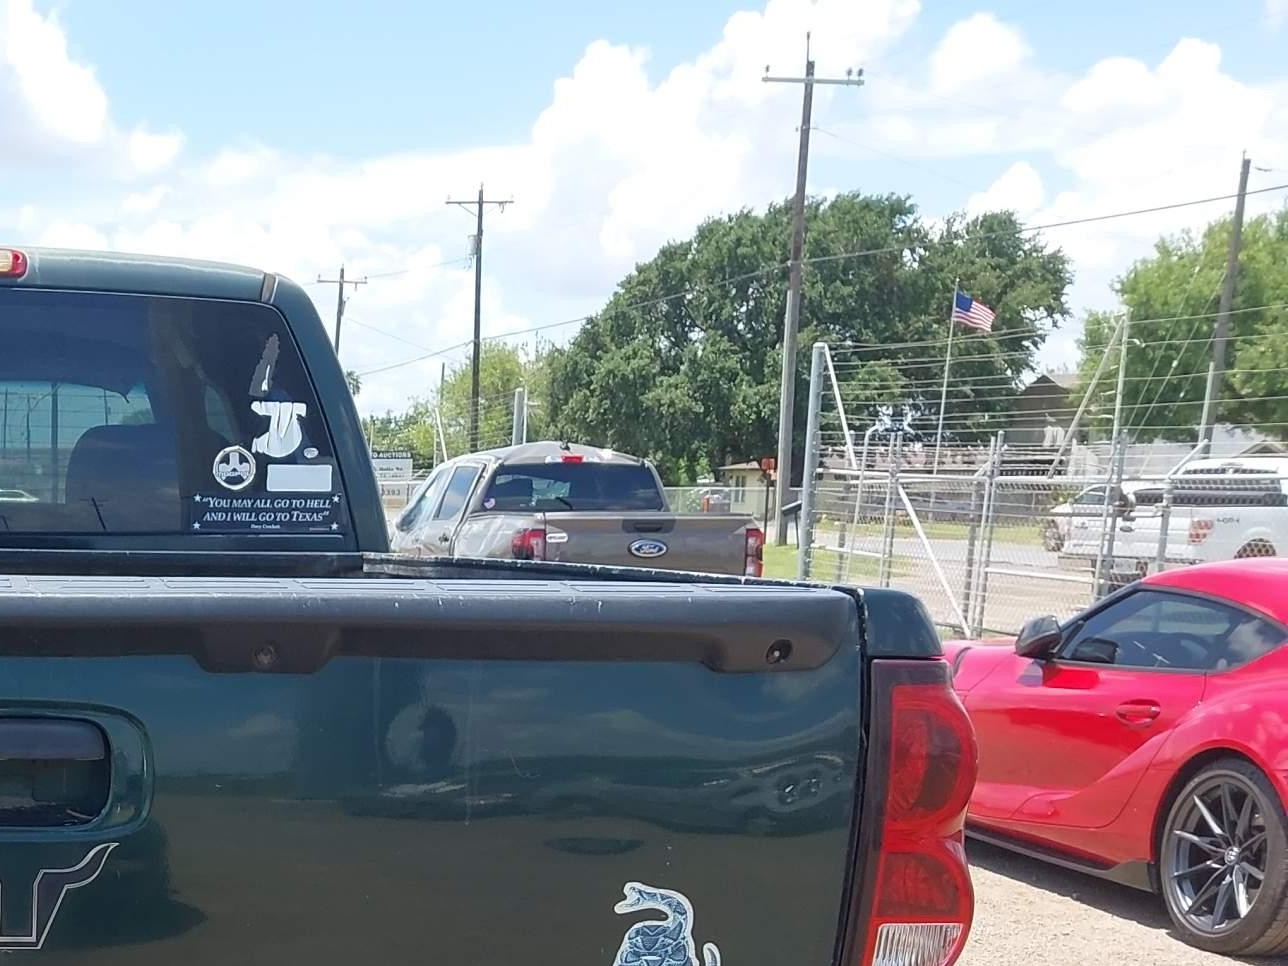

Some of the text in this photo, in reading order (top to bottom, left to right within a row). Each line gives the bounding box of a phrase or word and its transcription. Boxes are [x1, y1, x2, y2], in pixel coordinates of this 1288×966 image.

[232, 499, 253, 508] MAY
[253, 499, 272, 508] ALL
[274, 499, 291, 508] GO
[292, 499, 305, 508] TO
[306, 499, 331, 508] HELL
[203, 511, 225, 521] AND
[233, 511, 258, 521] WILL
[259, 511, 274, 521] GO
[275, 511, 290, 521] TO
